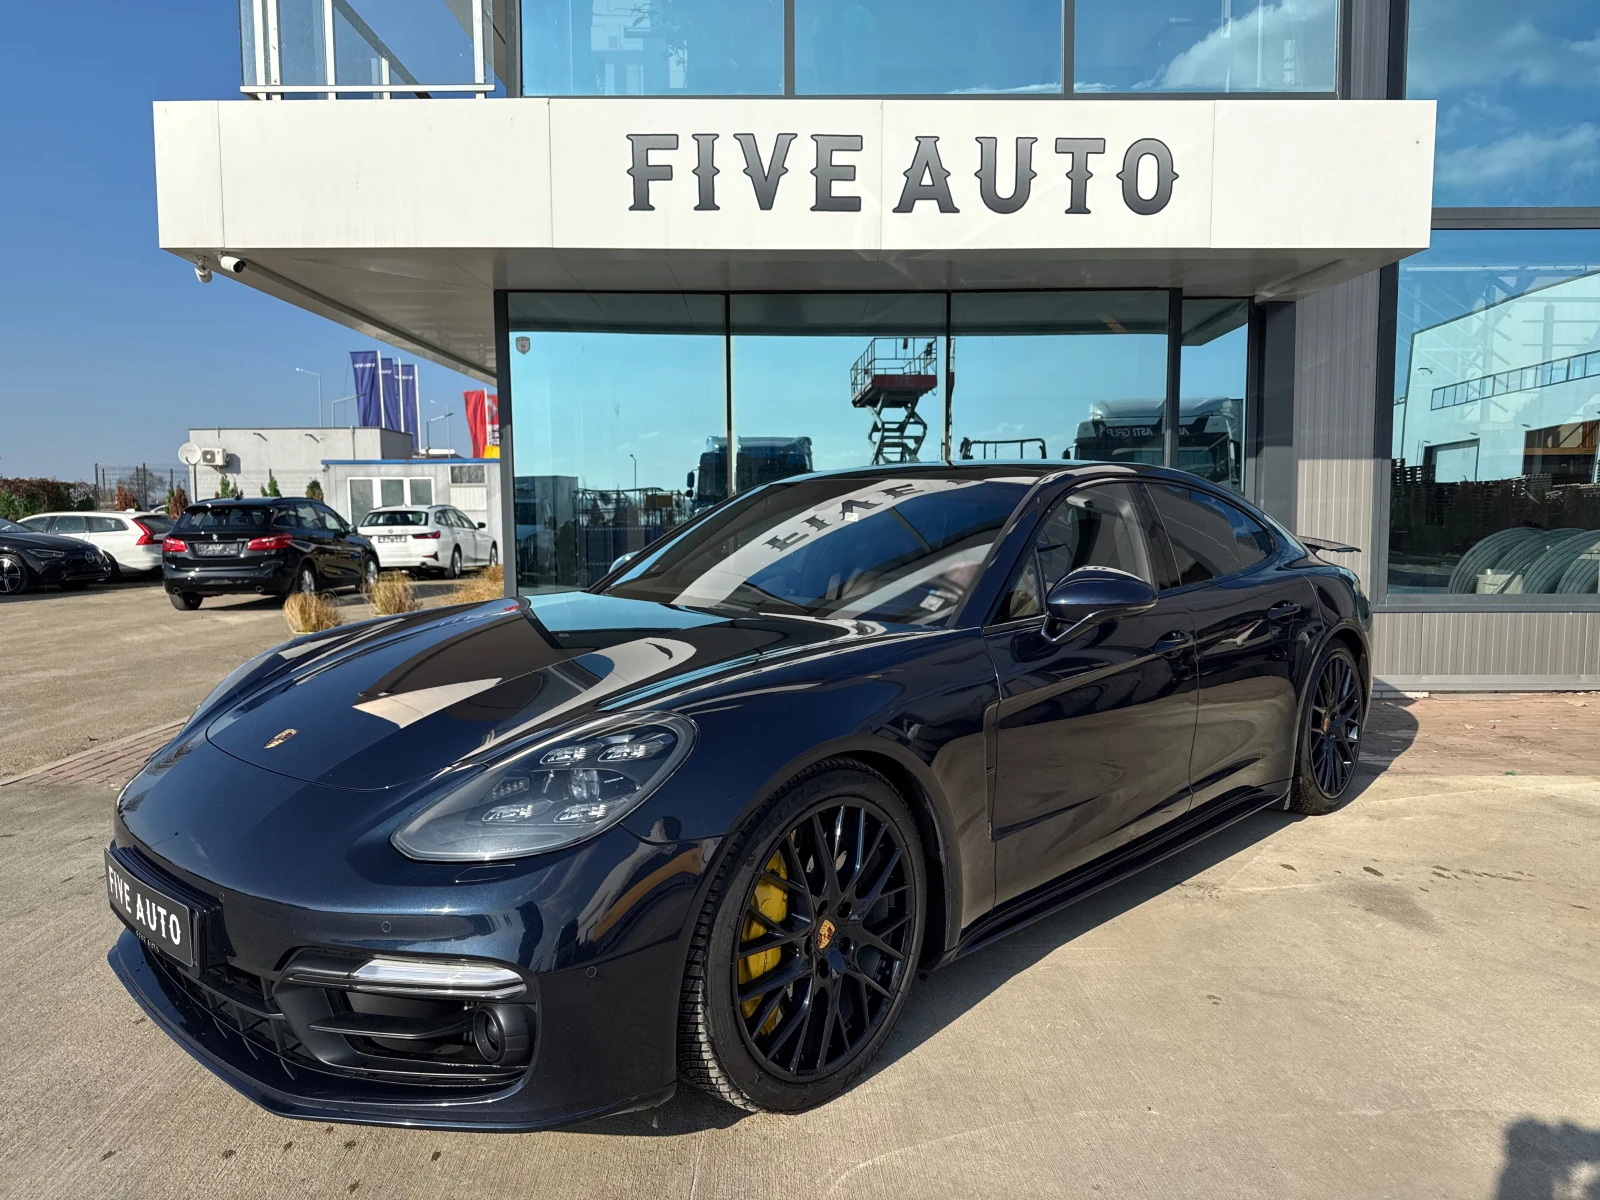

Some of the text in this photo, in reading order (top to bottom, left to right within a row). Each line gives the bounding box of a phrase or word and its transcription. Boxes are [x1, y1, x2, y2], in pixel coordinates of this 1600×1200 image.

[626, 133, 1179, 215] FIVE AUTO
[108, 865, 182, 946] FIVE AUTO
